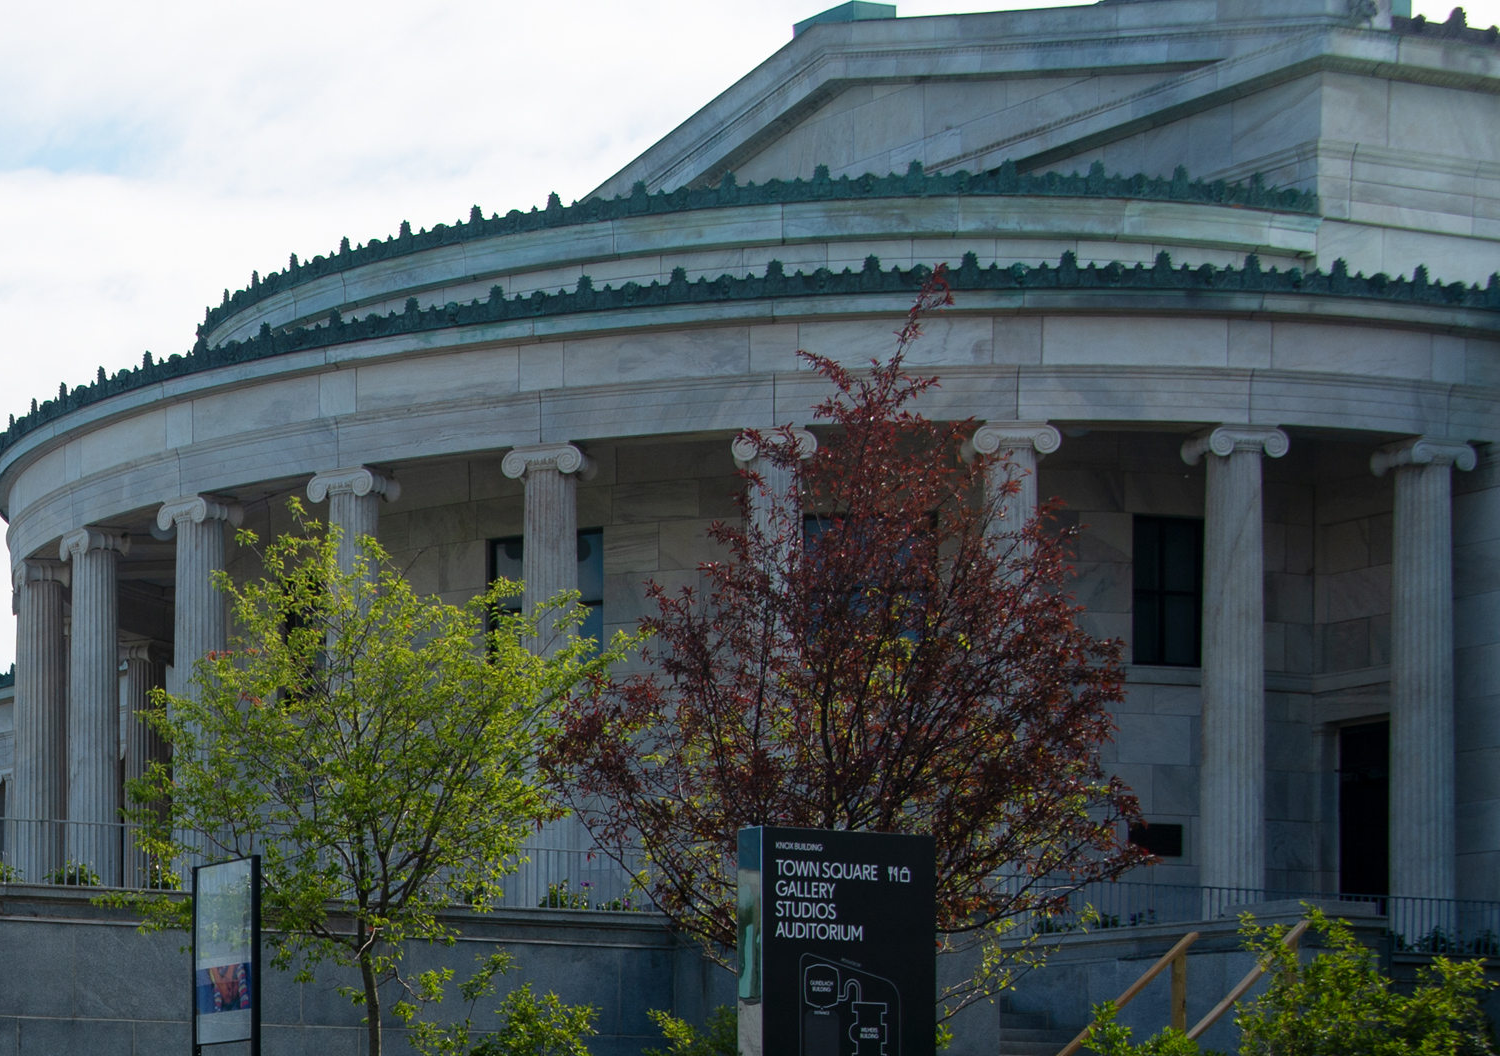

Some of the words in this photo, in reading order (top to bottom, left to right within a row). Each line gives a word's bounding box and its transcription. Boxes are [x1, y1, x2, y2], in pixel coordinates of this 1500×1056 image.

[775, 841, 794, 850] KNOX
[794, 842, 823, 852] BUILDING
[775, 859, 819, 878] TOWN
[822, 861, 878, 881] SQUARE
[775, 880, 836, 899] GALLERY
[775, 900, 836, 920] STUDIOS
[775, 921, 863, 942] AUDITORIUM
